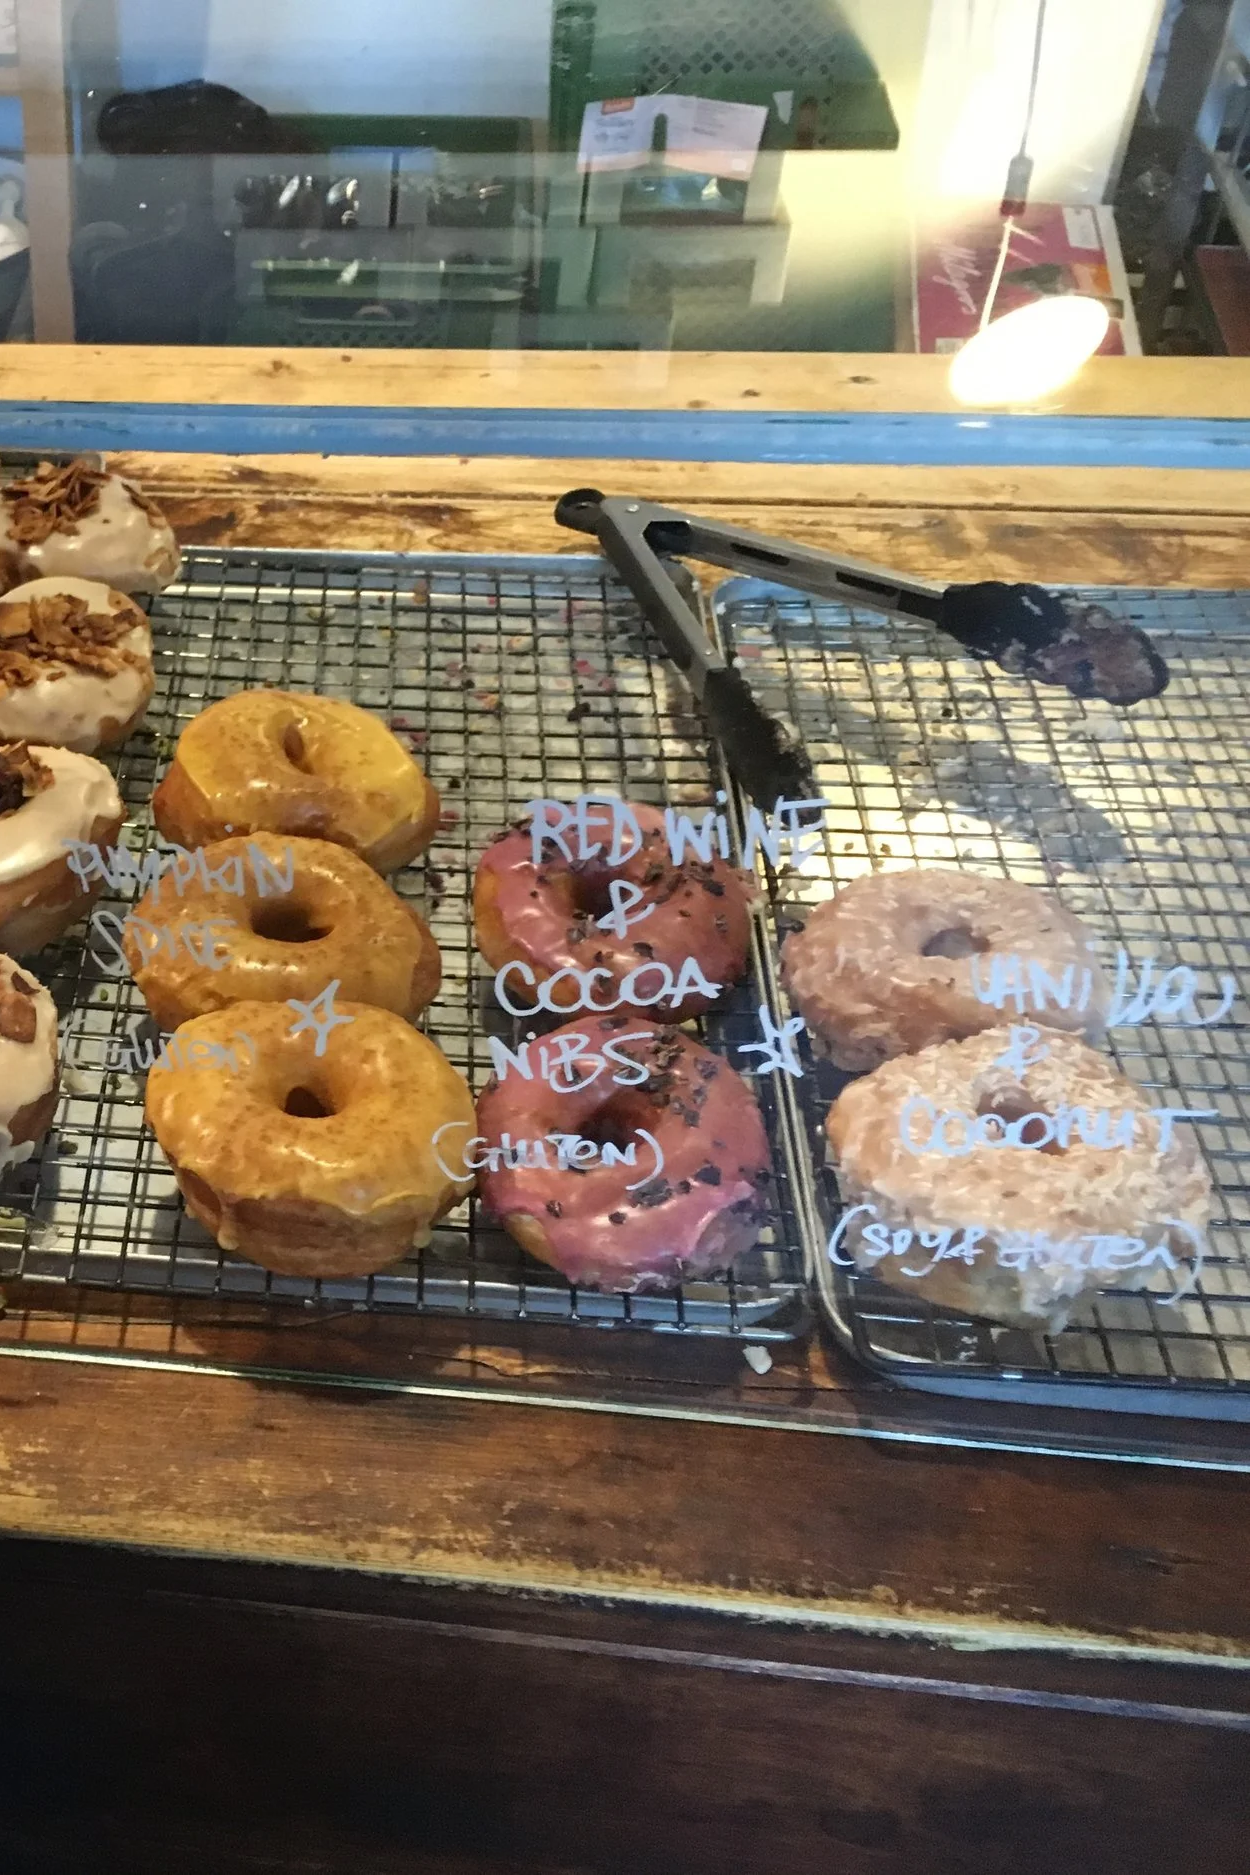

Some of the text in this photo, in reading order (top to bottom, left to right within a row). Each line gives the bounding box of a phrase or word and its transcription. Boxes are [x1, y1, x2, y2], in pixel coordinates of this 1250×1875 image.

[524, 793, 643, 867] RED
[596, 879, 657, 940] &
[89, 909, 238, 978] SPICE
[494, 957, 723, 1018] COCOA
[994, 1025, 1051, 1082] &
